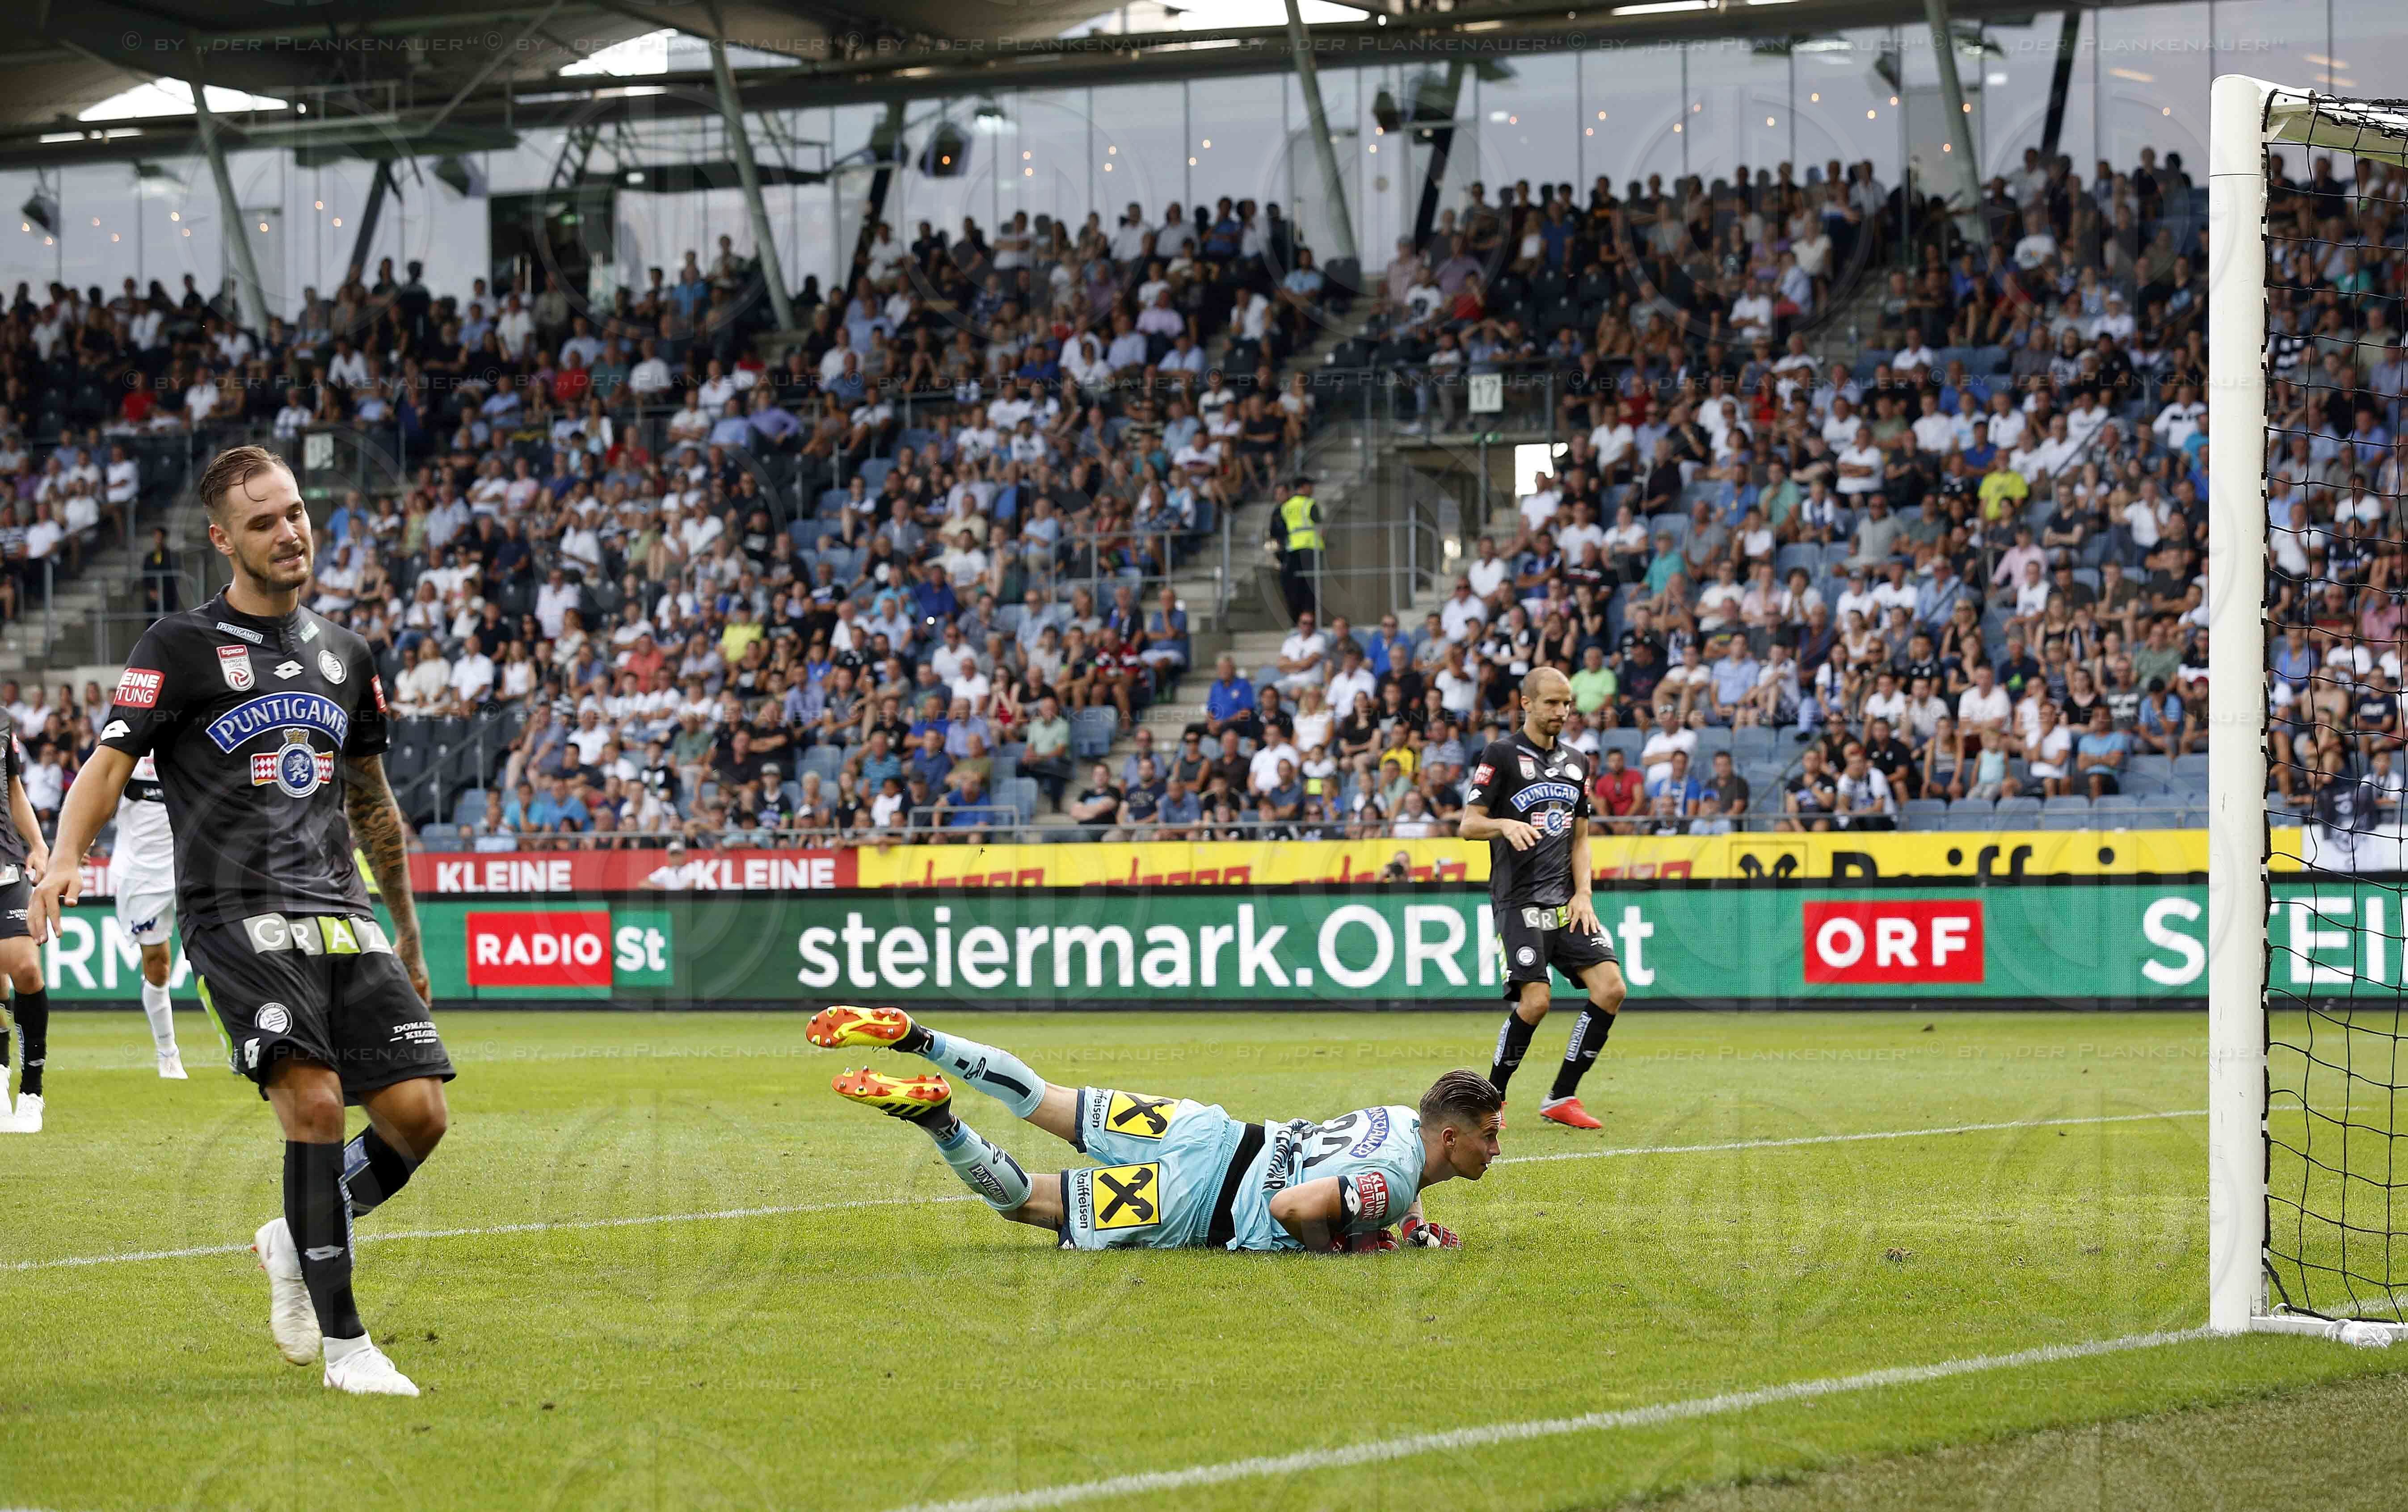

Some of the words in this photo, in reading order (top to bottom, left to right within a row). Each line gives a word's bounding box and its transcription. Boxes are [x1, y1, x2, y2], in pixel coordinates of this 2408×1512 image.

[220, 622, 261, 641] PUNTIGAMER
[437, 860, 572, 892] KLEINE
[694, 858, 835, 889] KLEINE
[476, 932, 602, 966] RADIO
[615, 926, 667, 972] St
[1816, 916, 1970, 968] ORF
[1077, 1172, 1090, 1229] Raiffeisen
